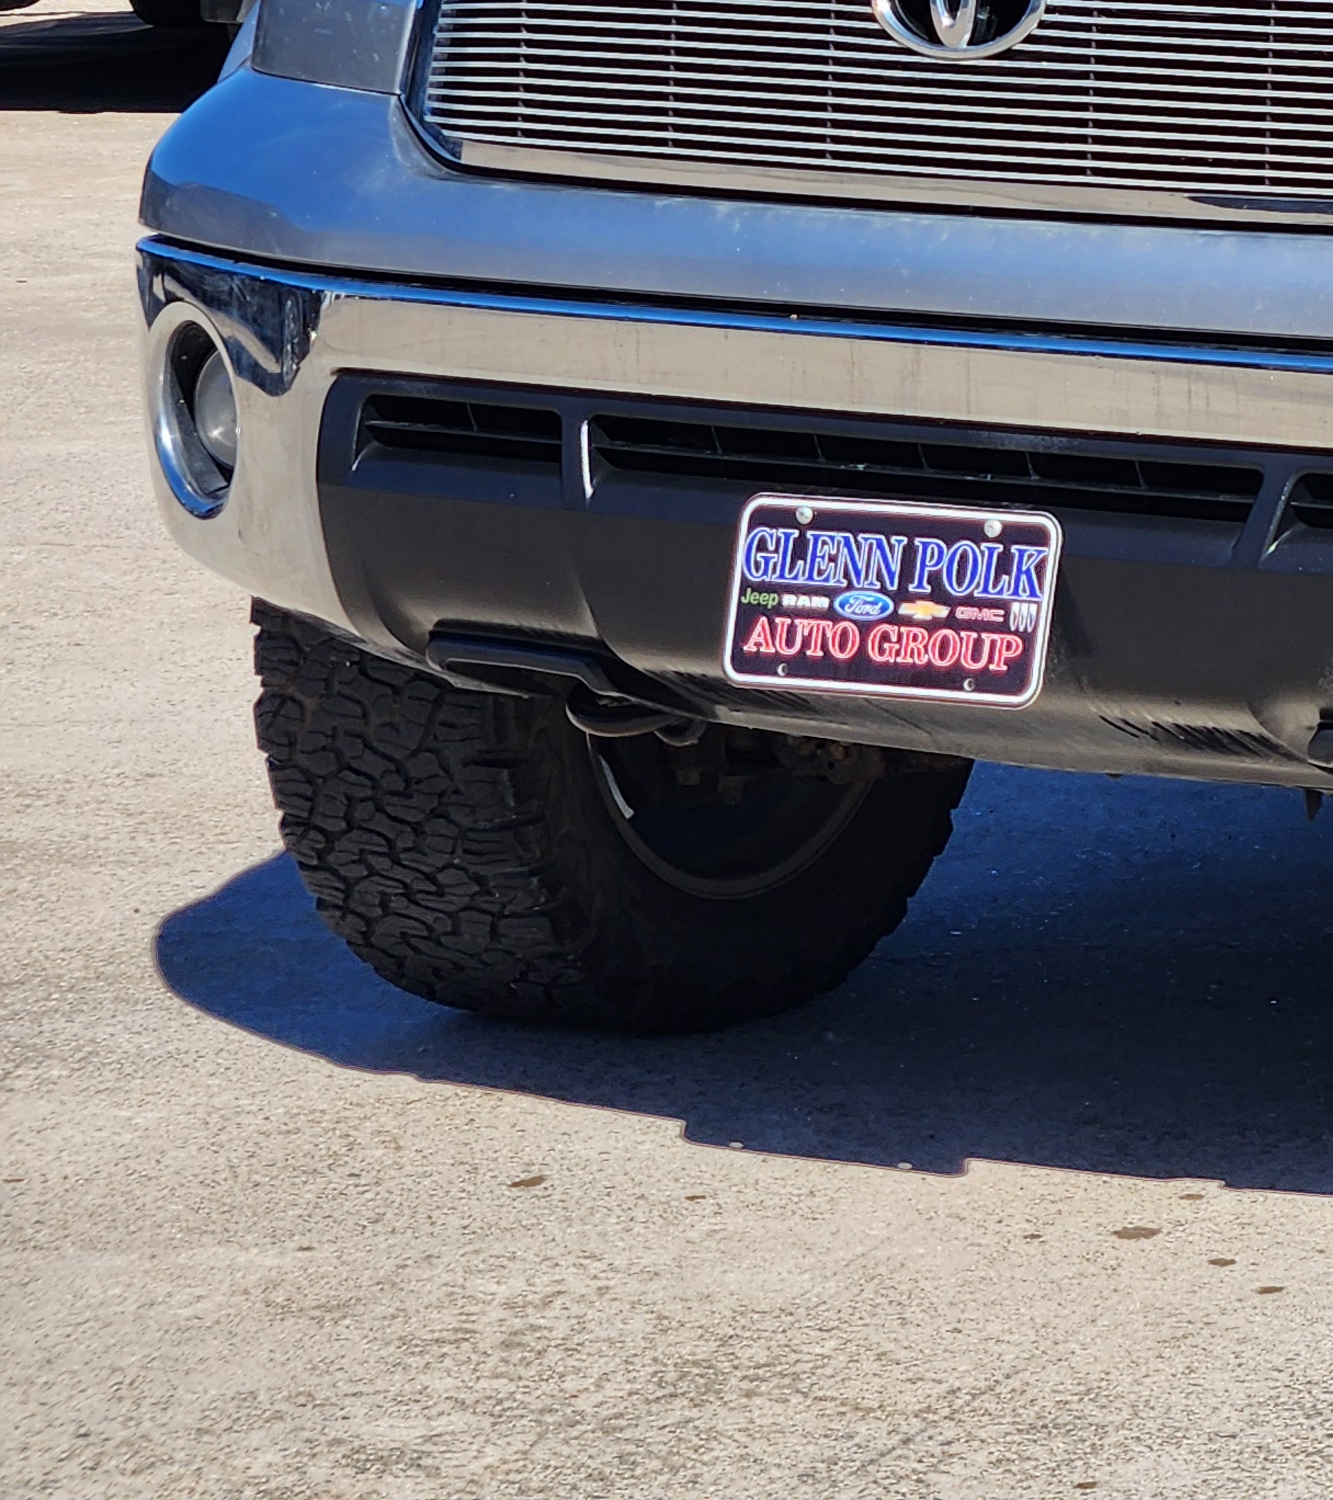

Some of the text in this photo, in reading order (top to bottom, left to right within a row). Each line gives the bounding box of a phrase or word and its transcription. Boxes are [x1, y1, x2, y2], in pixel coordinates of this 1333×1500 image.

[742, 526, 1050, 601] GLENN POLK
[741, 587, 1005, 622] Jeep RAM Ford GMC
[743, 615, 1024, 672] AUTO GROUP
